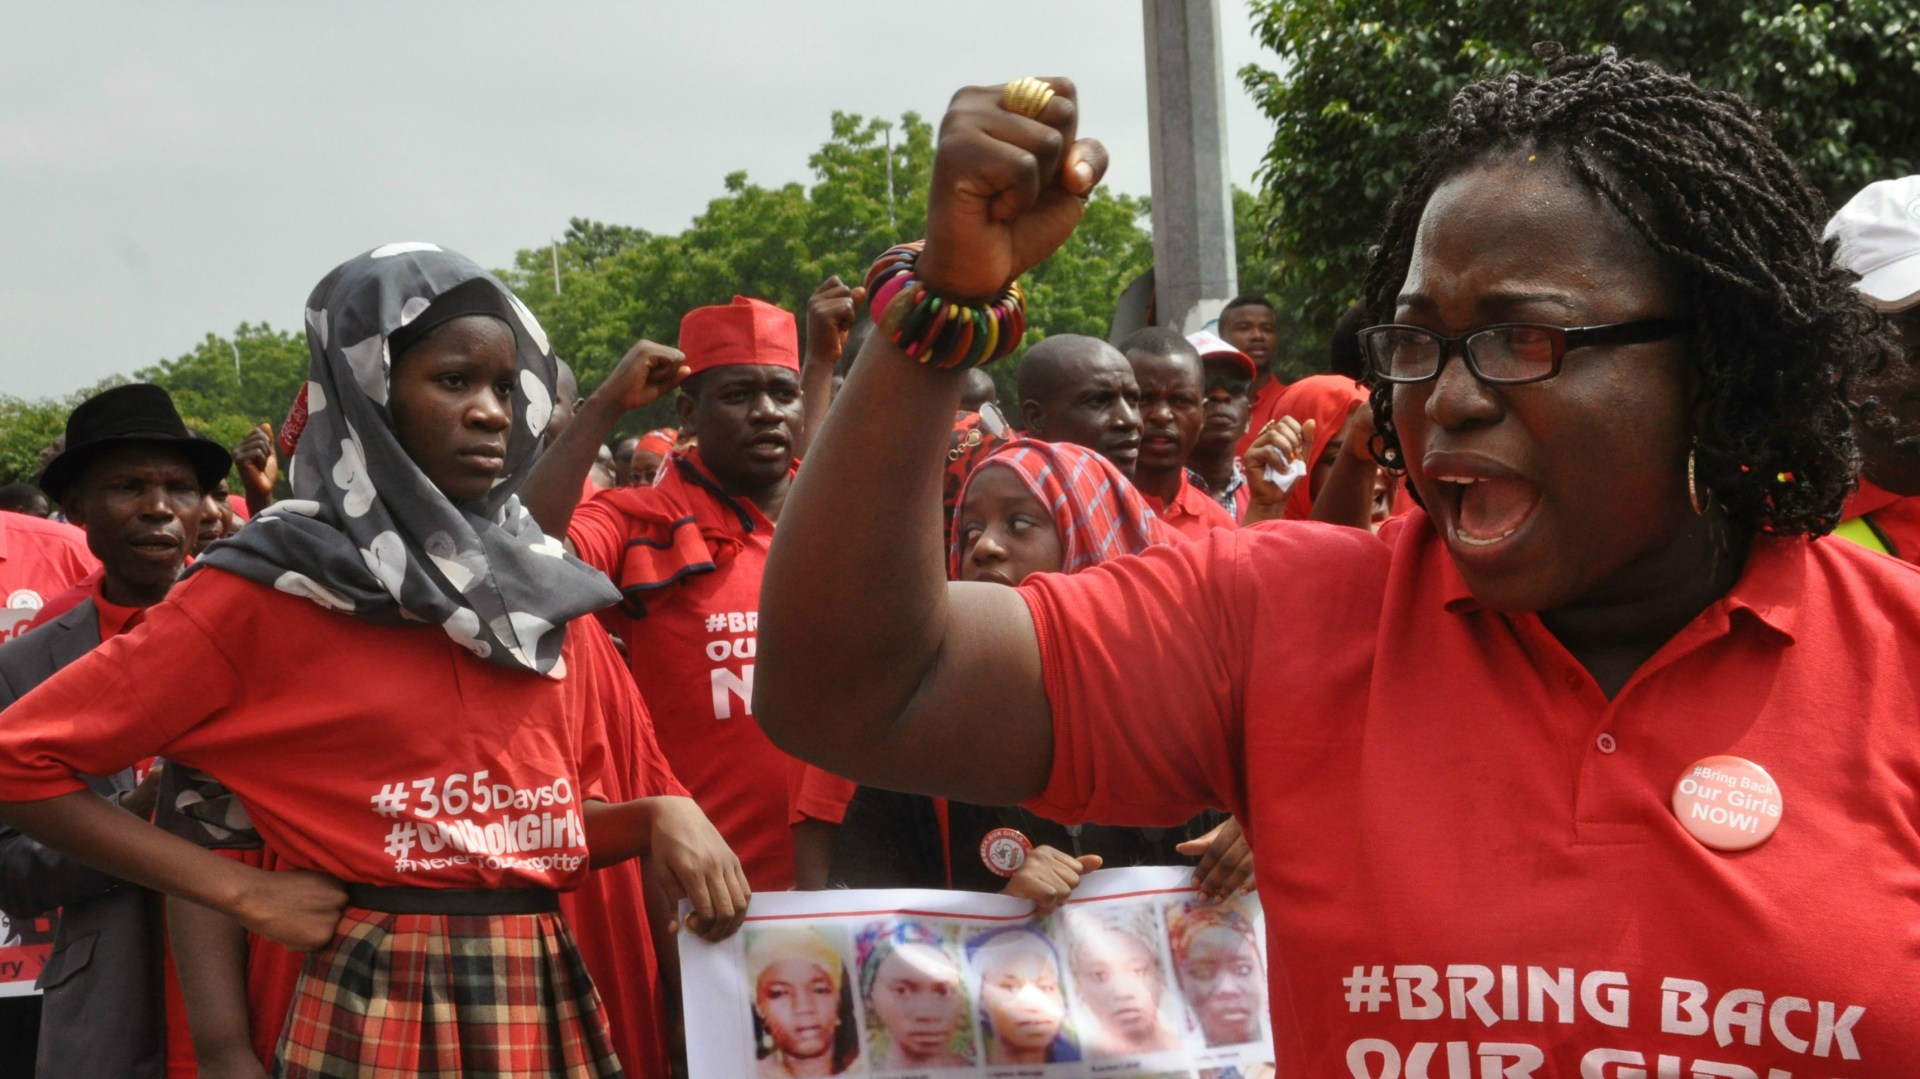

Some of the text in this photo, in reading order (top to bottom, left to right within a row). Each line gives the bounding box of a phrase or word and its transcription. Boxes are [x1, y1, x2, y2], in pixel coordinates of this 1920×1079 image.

[371, 769, 575, 819] #365DaysO
[1679, 779, 1780, 818] Our Girls
[1693, 765, 1774, 795] #Bring Back
[988, 831, 1002, 841] OUR
[1003, 831, 1024, 842] GIRLS
[1691, 802, 1759, 834] NOW!
[1342, 964, 1866, 1061] #BRING BACK
[1345, 1038, 1545, 1079] OUR
